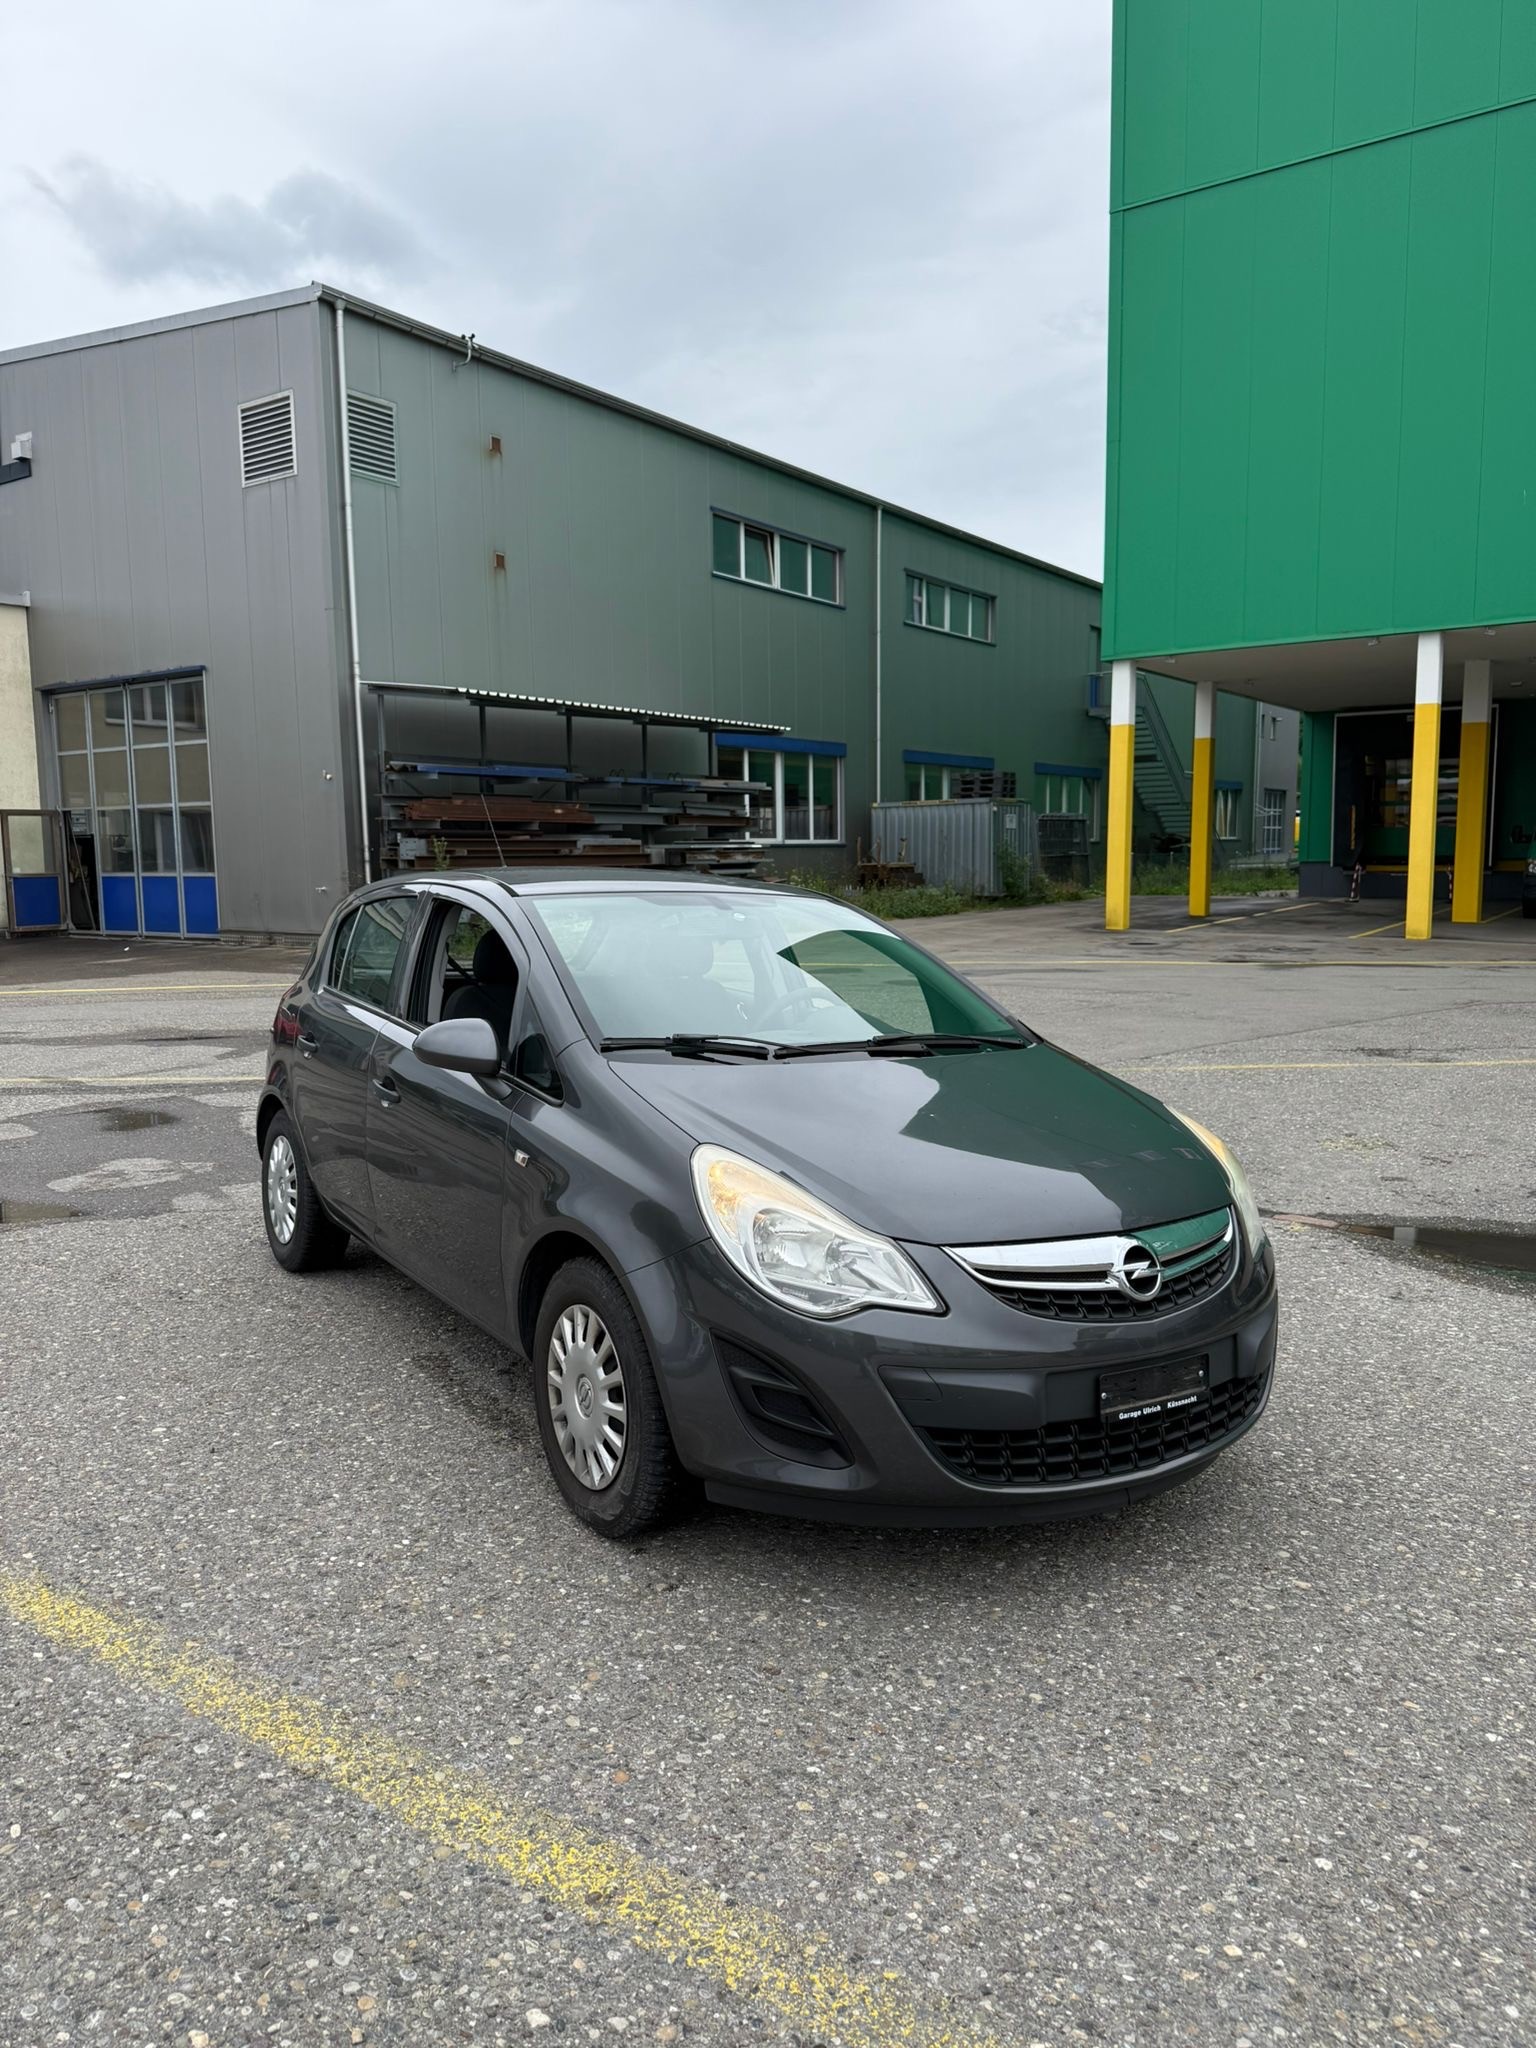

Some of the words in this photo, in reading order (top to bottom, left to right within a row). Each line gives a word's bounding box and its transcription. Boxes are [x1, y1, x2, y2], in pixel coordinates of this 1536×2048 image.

[1119, 1410, 1142, 1420] Garage
[1143, 1405, 1161, 1415] Ulrich
[1167, 1395, 1198, 1409] Küssnacht
